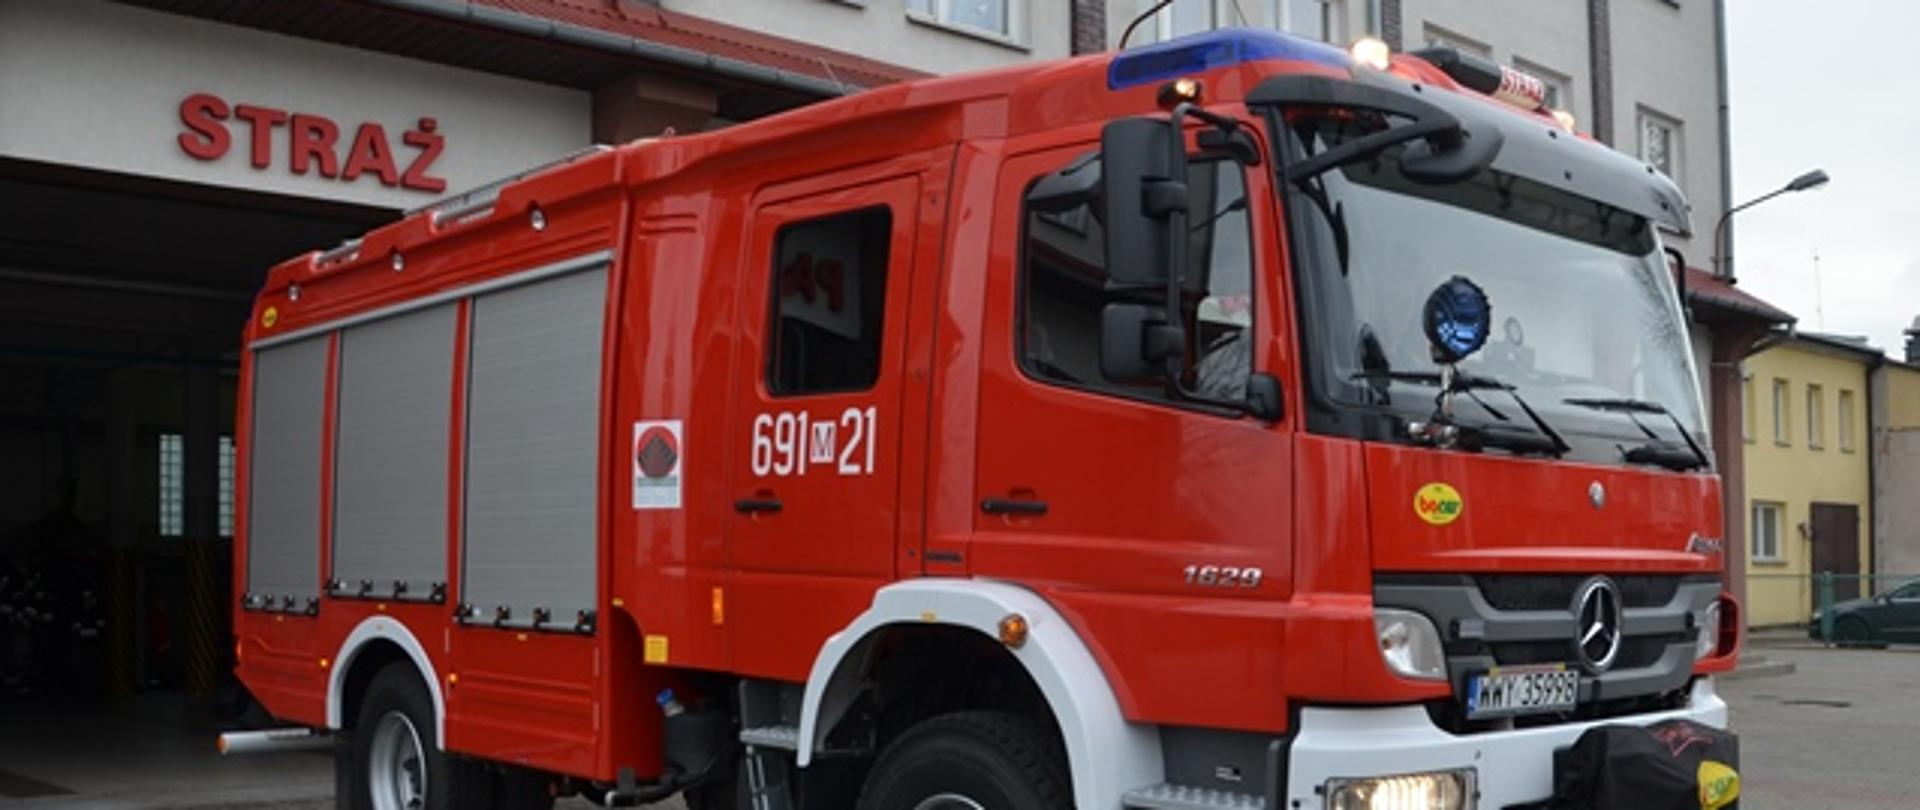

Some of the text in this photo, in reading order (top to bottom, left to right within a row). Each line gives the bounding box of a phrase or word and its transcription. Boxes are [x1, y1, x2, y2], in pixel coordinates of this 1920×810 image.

[178, 93, 446, 193] STRAŻ
[751, 406, 877, 477] 691 M 21
[1183, 564, 1263, 588] 1629
[1480, 671, 1576, 707] WWY 35998
